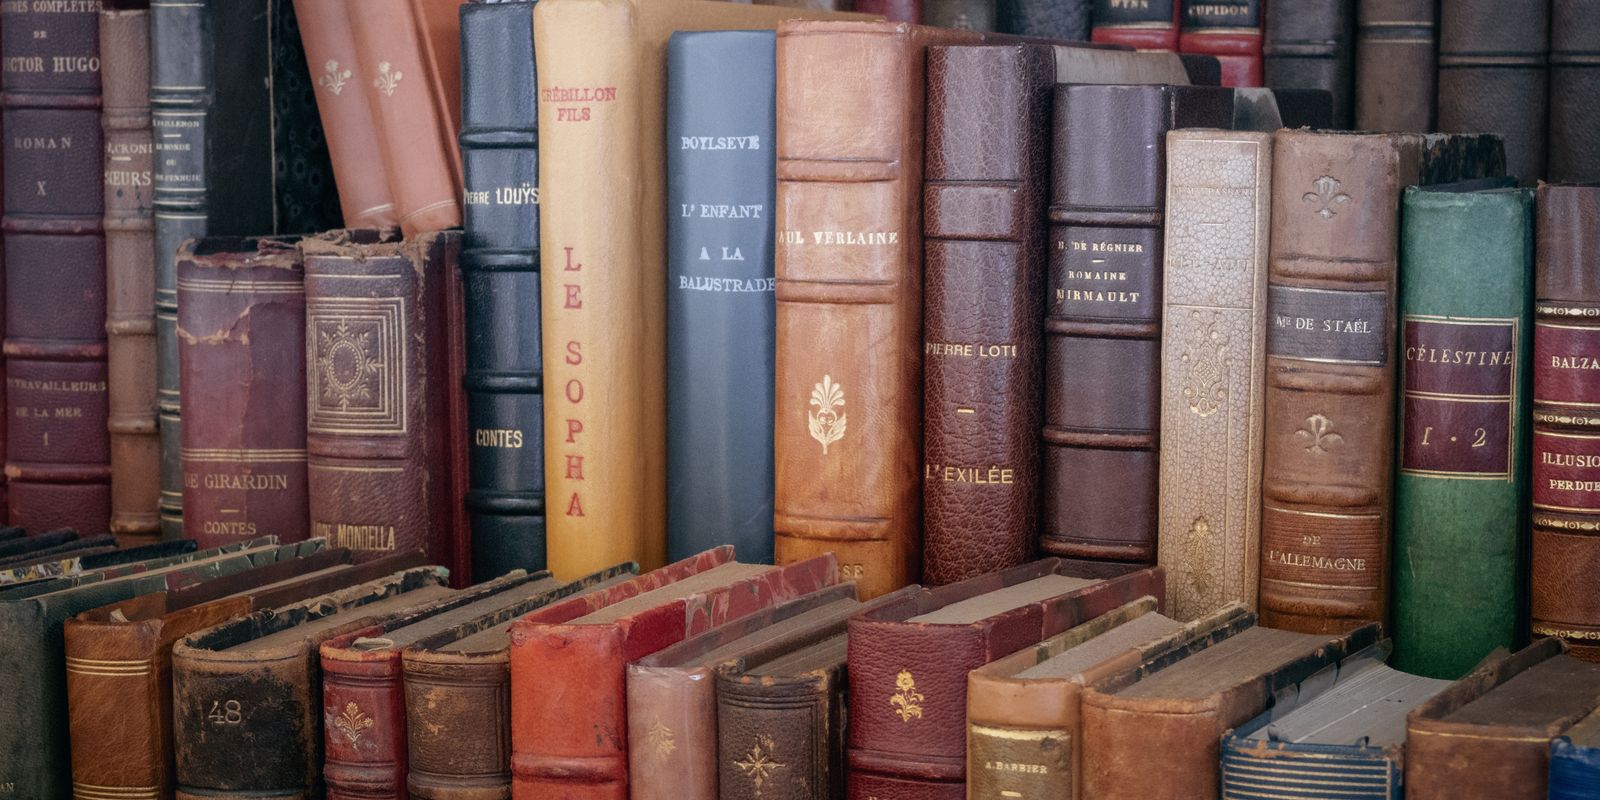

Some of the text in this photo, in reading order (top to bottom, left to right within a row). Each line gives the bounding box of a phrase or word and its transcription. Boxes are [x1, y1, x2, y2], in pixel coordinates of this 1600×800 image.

[1189, 4, 1248, 16] CUPIDON
[53, 56, 100, 72] HUGO
[557, 107, 591, 121] FILS
[14, 137, 72, 149] ROMAN
[37, 180, 46, 196] X
[496, 182, 540, 205] LOUŸS
[814, 231, 898, 246] VERLAINE
[699, 246, 745, 260] A LA
[1092, 242, 1144, 253] RÉGNIER
[1068, 270, 1127, 281] ROMAINE
[679, 275, 775, 293] BALUSTRADE
[1295, 317, 1315, 331] DE
[926, 342, 973, 356] PIERRE
[1406, 344, 1514, 366] CÉLESTINE
[54, 407, 82, 417] MER
[476, 429, 524, 448] CONTES
[1471, 427, 1487, 448] 2
[204, 473, 289, 490] GIRARDIN
[204, 521, 257, 535] CONTES
[1302, 535, 1321, 545] DE
[1269, 550, 1367, 571] L'ALLEMAGNE
[208, 699, 242, 724] 48
